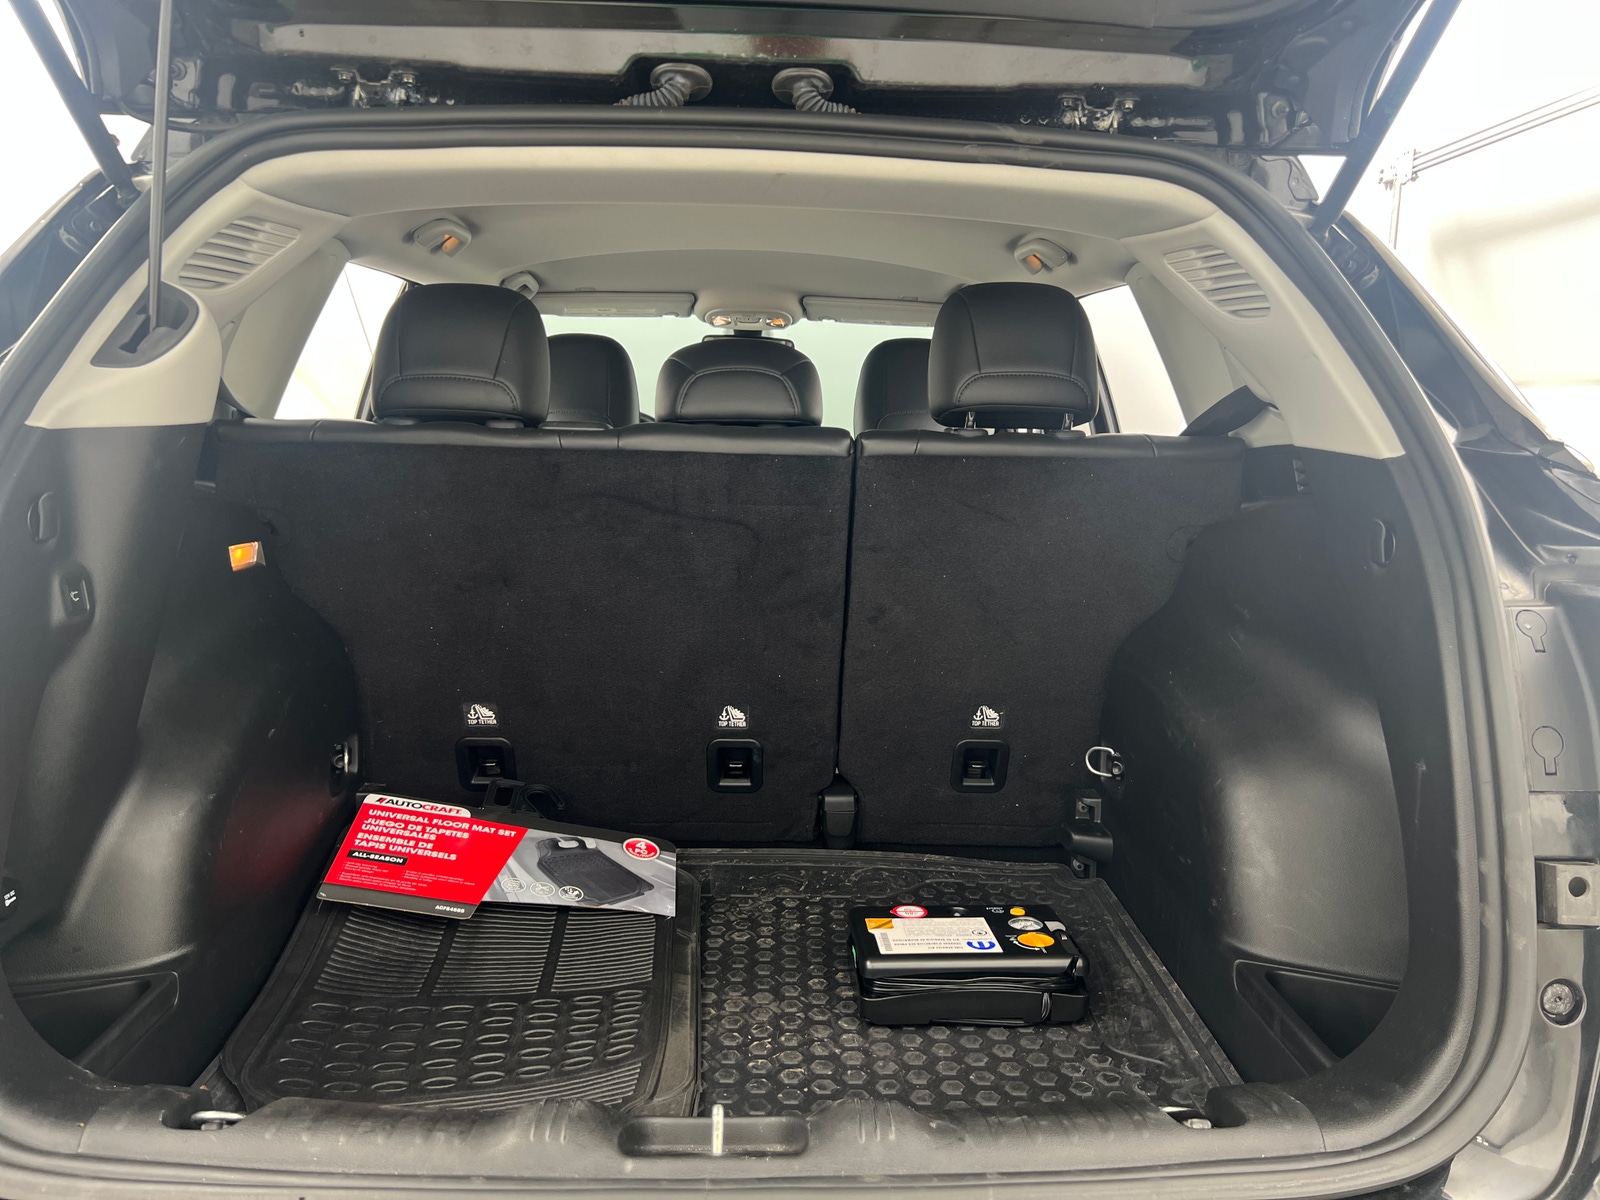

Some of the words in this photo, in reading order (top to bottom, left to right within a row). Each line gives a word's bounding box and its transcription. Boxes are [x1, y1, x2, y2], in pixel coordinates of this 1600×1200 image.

[384, 798, 462, 815] AUTOCRAFT
[361, 823, 437, 841] UNIVERSALES
[364, 818, 405, 829] JUEGO
[407, 824, 423, 832] DE
[425, 826, 470, 839] TAPETES
[368, 809, 430, 824] UNIVERSAL
[431, 818, 470, 830] FLOOR
[471, 824, 496, 835] MAT
[497, 829, 517, 838] SET
[354, 839, 387, 850] TAPIS
[388, 845, 457, 861] UNIVERSELS
[356, 832, 416, 847] ENSEMBLE
[418, 841, 434, 850] DE
[636, 842, 647, 850] 4
[352, 851, 404, 864] ALL-SEASON
